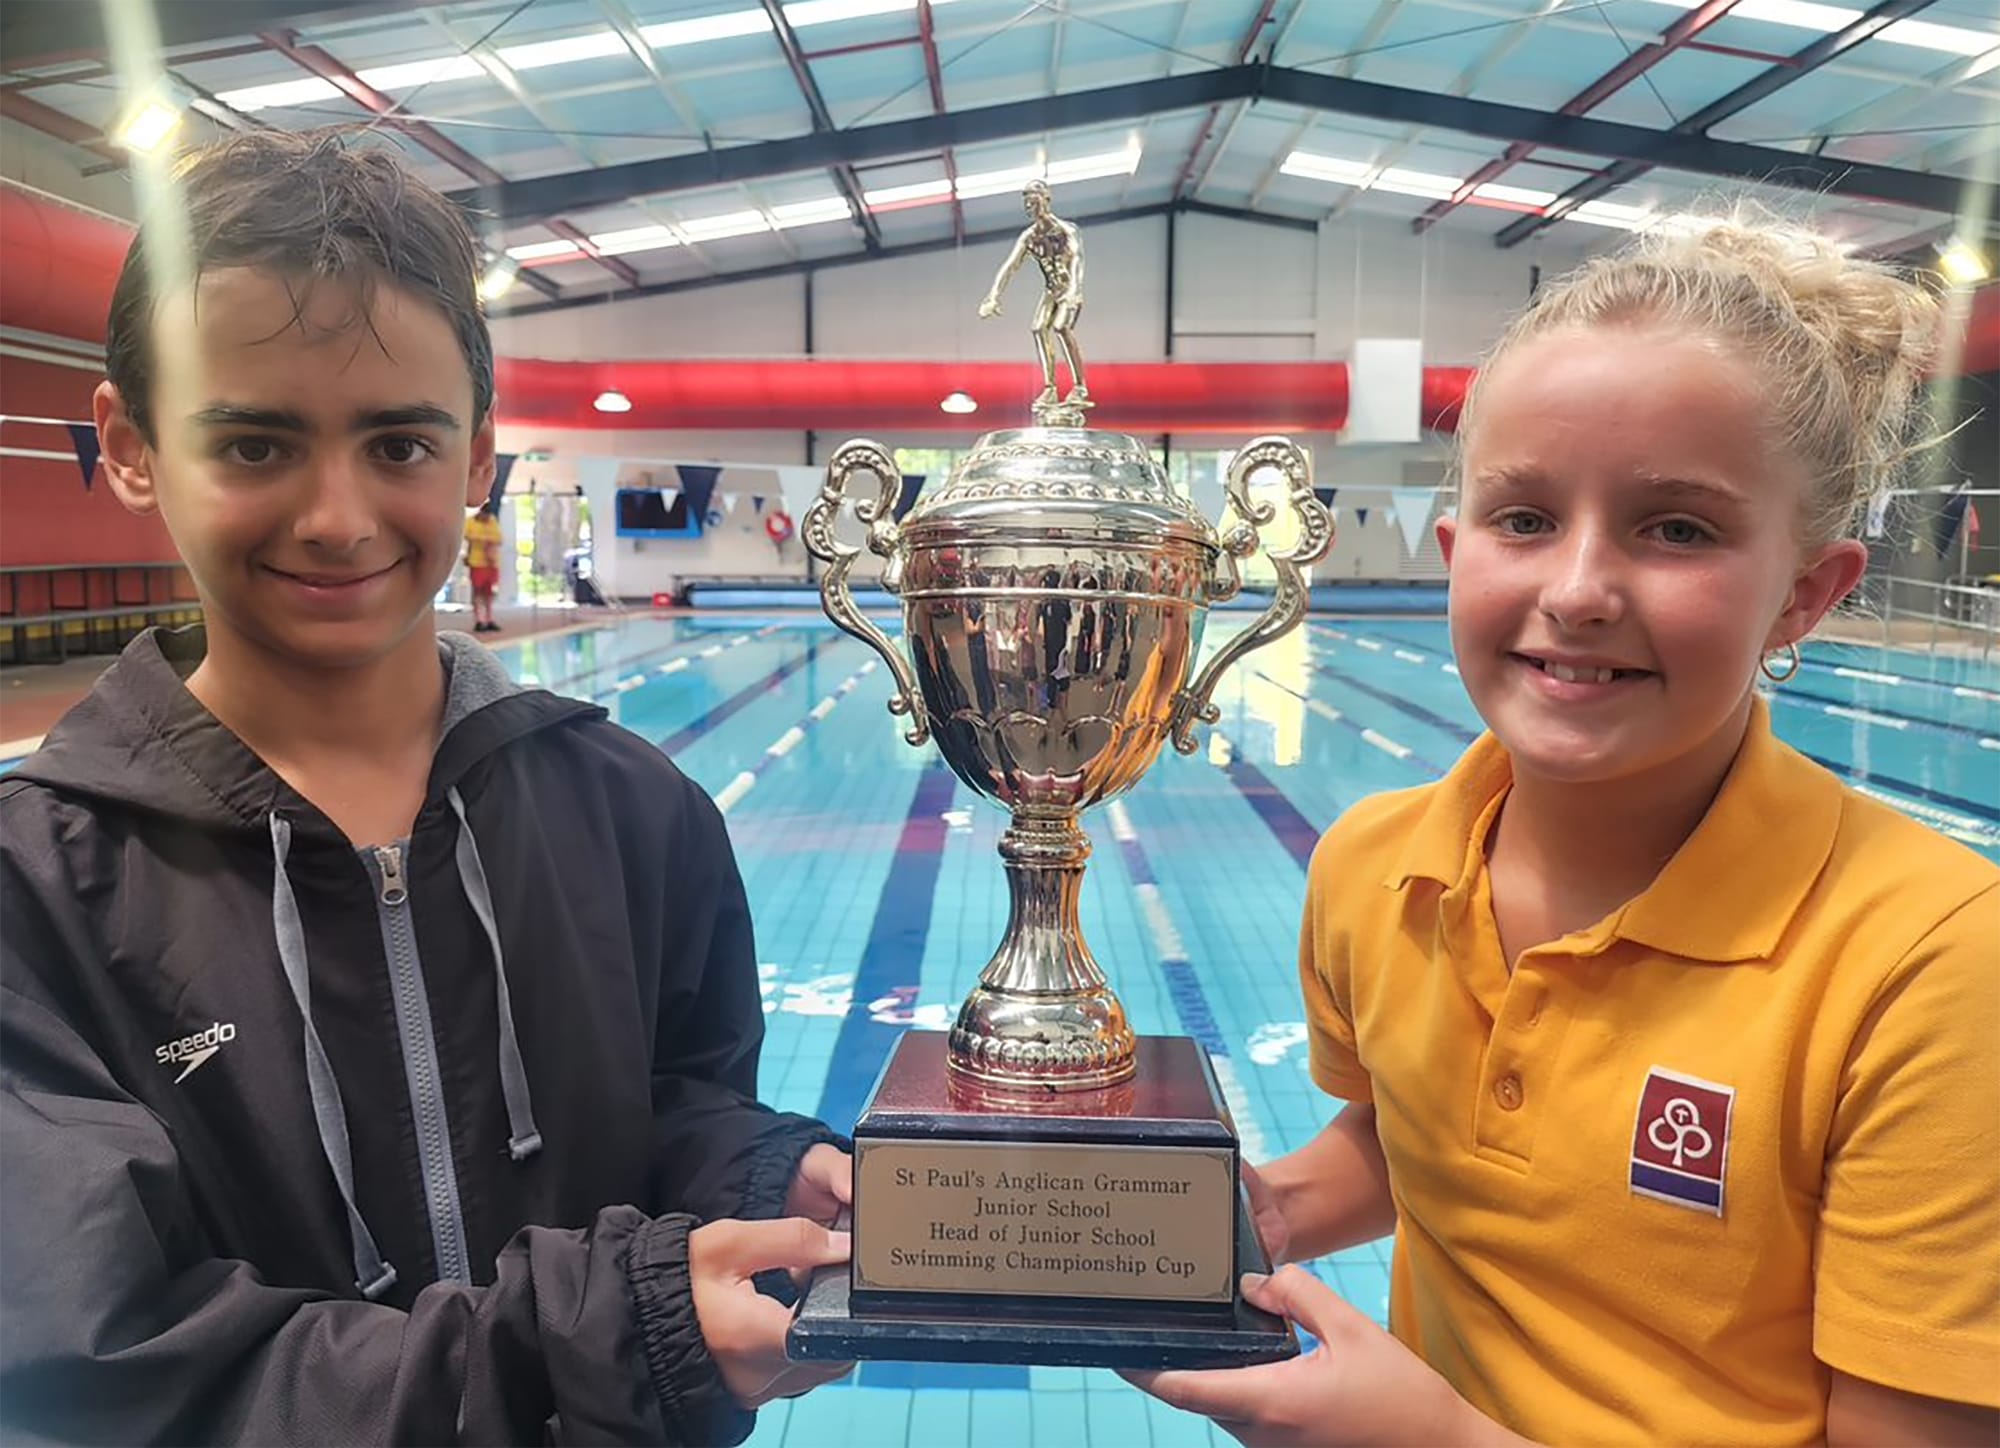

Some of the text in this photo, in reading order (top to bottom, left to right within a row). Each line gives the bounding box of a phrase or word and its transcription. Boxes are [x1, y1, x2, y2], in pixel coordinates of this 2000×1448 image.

[155, 1022, 236, 1064] speedo
[894, 1167, 1193, 1195] St Paul's Anglican Grammar
[974, 1197, 1112, 1220] Junior School
[929, 1222, 1157, 1248] Head of Junior School
[890, 1248, 1197, 1278] Swimming Championship Cup
